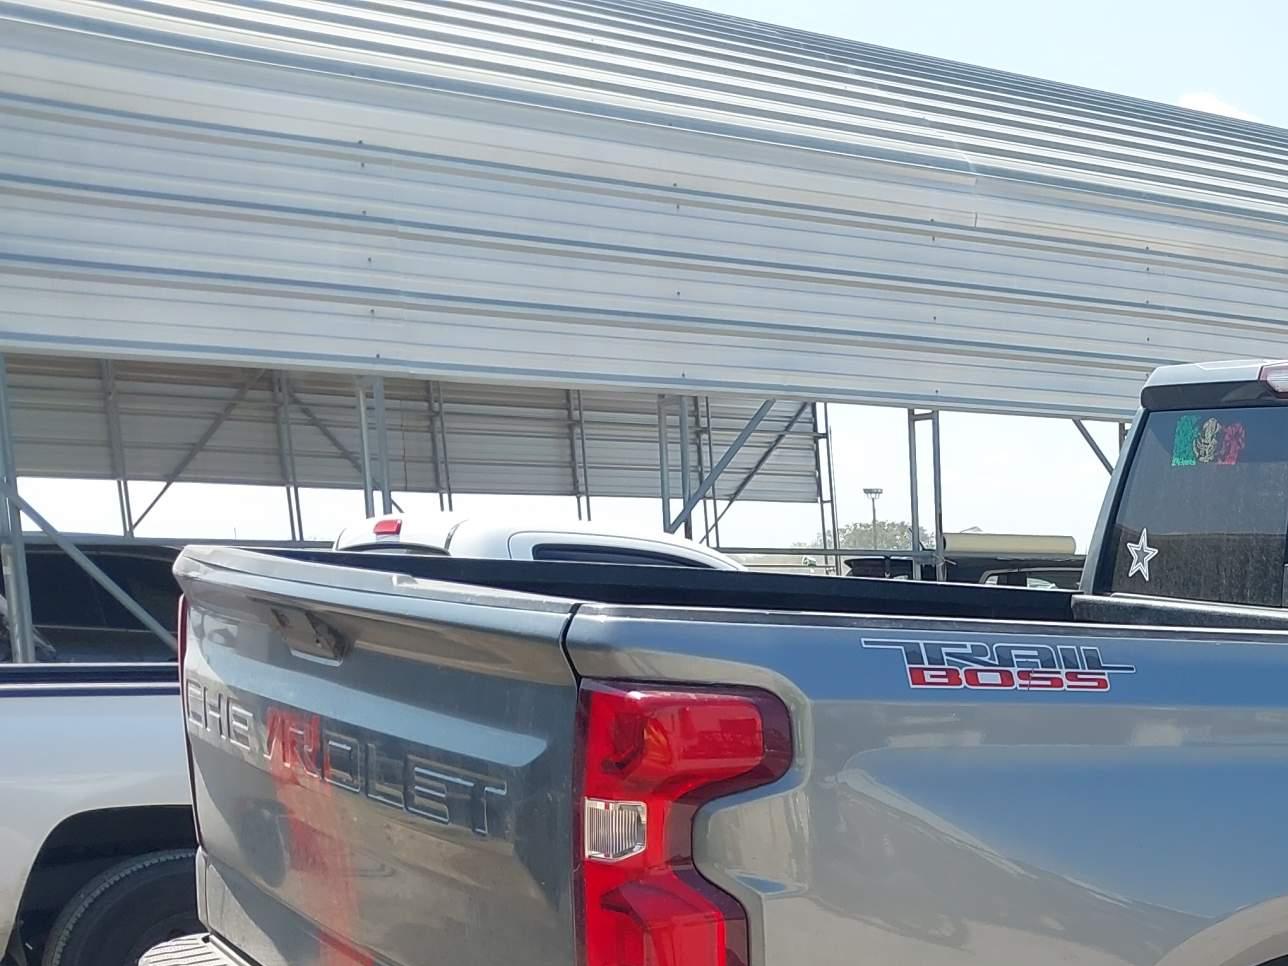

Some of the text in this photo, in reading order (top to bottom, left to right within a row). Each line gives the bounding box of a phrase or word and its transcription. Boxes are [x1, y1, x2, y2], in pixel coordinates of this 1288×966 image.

[860, 637, 1136, 673] TRAIL
[907, 665, 1111, 692] BOSS
[185, 676, 508, 836] CHEVROLET
